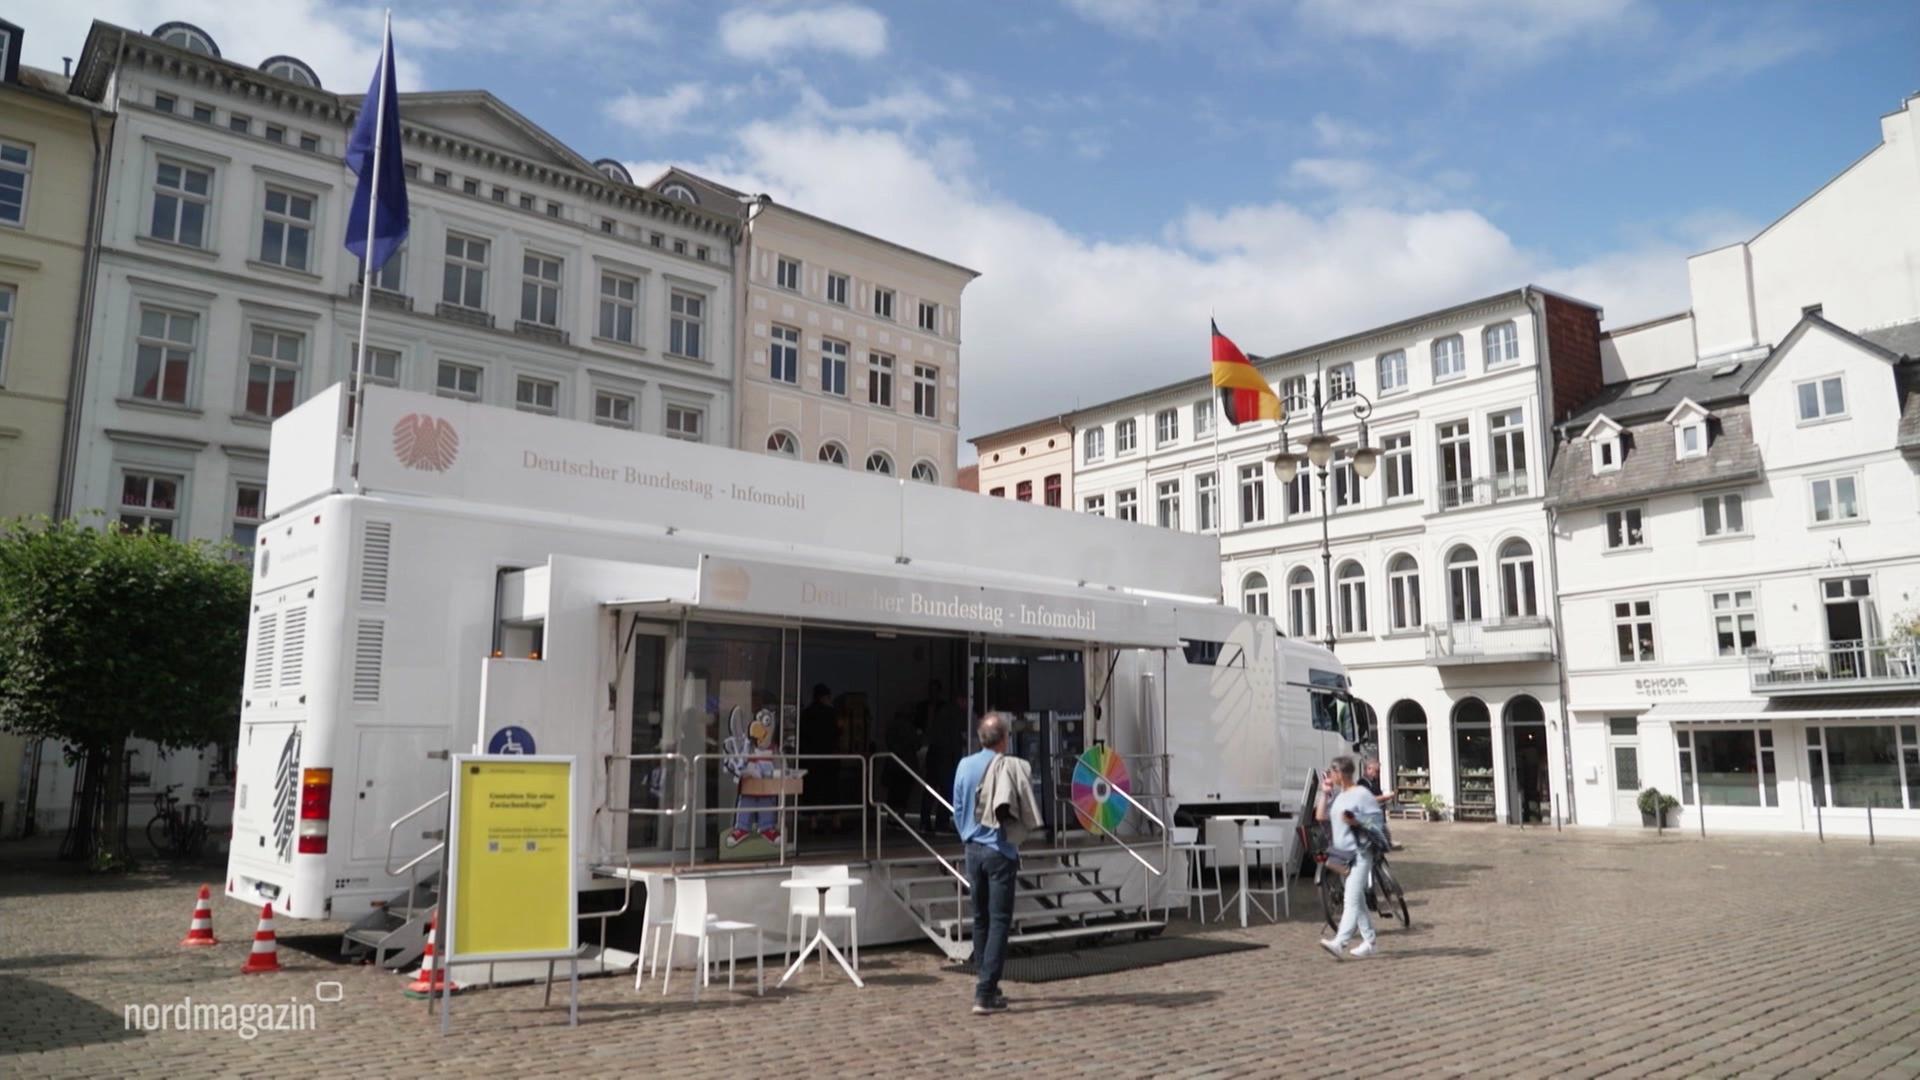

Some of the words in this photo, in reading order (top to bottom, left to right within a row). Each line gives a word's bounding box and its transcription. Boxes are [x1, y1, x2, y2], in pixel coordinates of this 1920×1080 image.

[522, 450, 619, 482] Deutscher
[624, 466, 713, 499] Bundestag
[731, 483, 806, 510] Infomobil
[801, 582, 905, 613] Deuther
[911, 592, 1003, 628] Bundestag
[1020, 604, 1097, 632] Infomobil
[1635, 677, 1688, 689] SCHOOR
